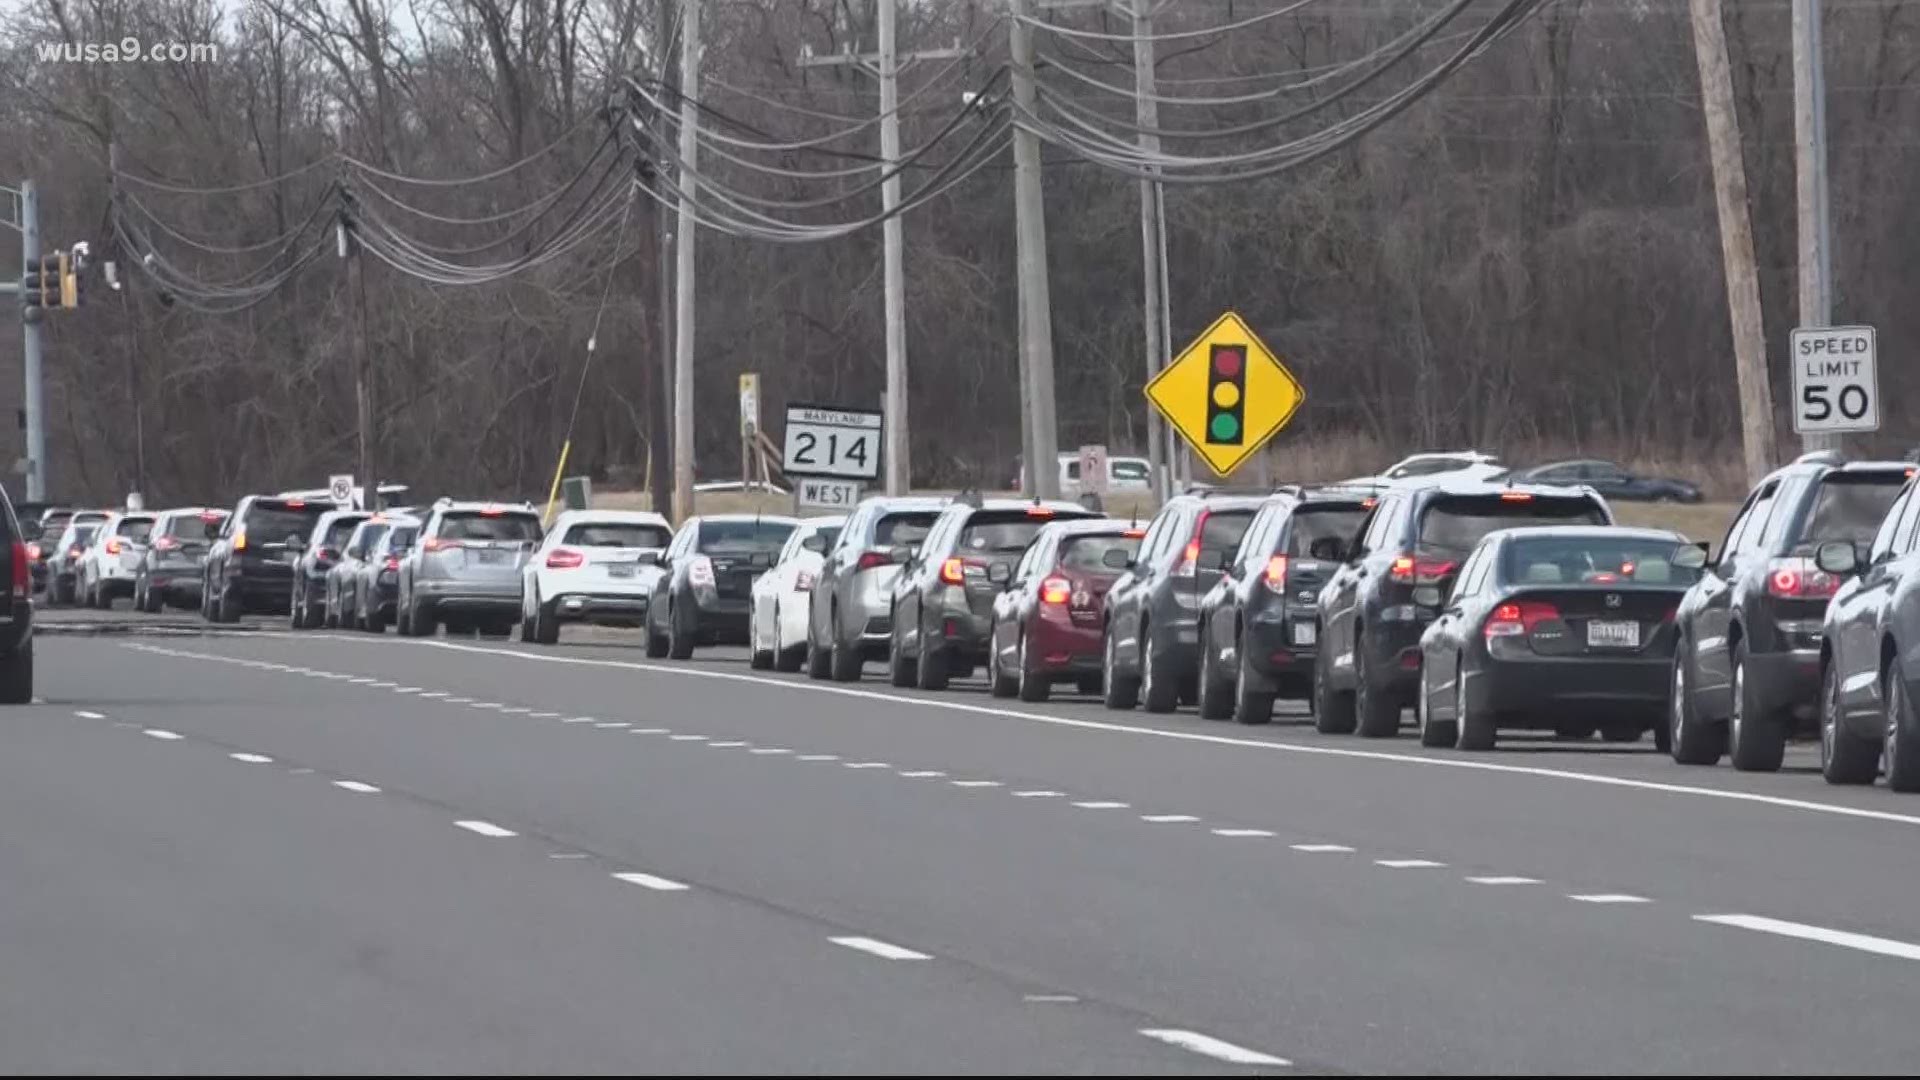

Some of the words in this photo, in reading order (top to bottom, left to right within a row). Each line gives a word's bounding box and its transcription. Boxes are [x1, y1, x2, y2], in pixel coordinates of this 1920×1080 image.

[1801, 338, 1867, 355] SPEED
[1807, 361, 1860, 376] LIMIT
[1804, 384, 1868, 420] 50
[794, 432, 867, 468] 214
[806, 485, 851, 504] WEST
